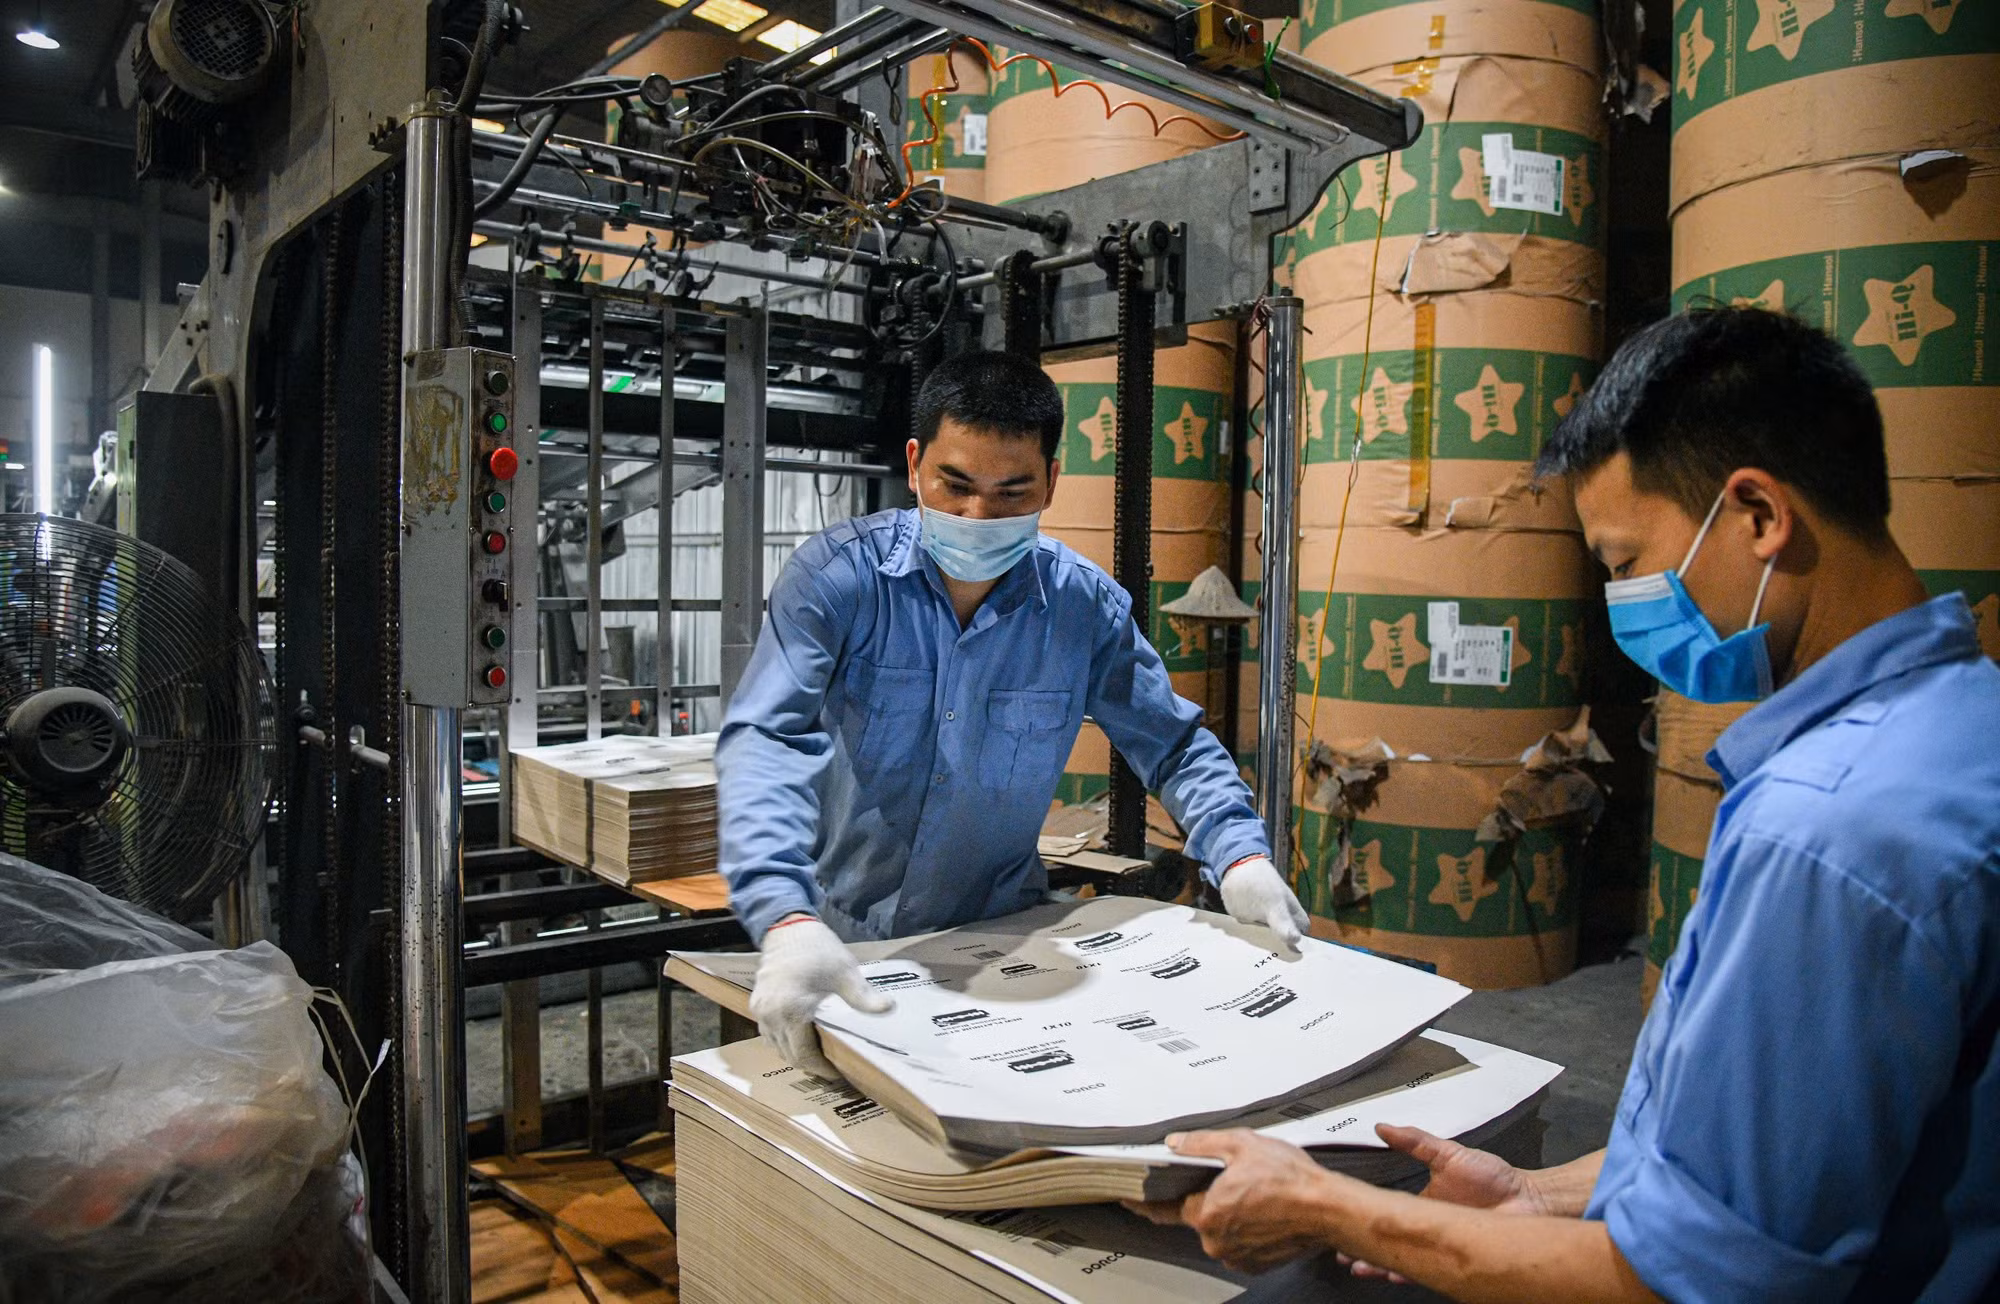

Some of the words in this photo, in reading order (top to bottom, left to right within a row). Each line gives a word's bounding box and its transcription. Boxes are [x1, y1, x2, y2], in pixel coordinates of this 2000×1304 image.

[1778, 0, 1800, 38] Hi-
[1853, 20, 1865, 58] Hansol
[1891, 283, 1918, 341] Hi-Q
[1975, 292, 1986, 331] Hansol
[1482, 384, 1499, 428] Hi-Q
[1387, 626, 1405, 669] Hi-Q
[1254, 952, 1279, 968] 1X10
[1042, 1021, 1072, 1031] 1X10
[1300, 1011, 1334, 1030] DORCO
[993, 1045, 1038, 1057] PLATINUM
[1189, 1055, 1227, 1068] DORCO
[762, 1066, 794, 1078] ORCO
[1406, 1071, 1435, 1089] DORCO
[1062, 1082, 1106, 1095] DORCO
[1326, 1117, 1358, 1133] DORCO
[1081, 1251, 1126, 1275] DORCO
